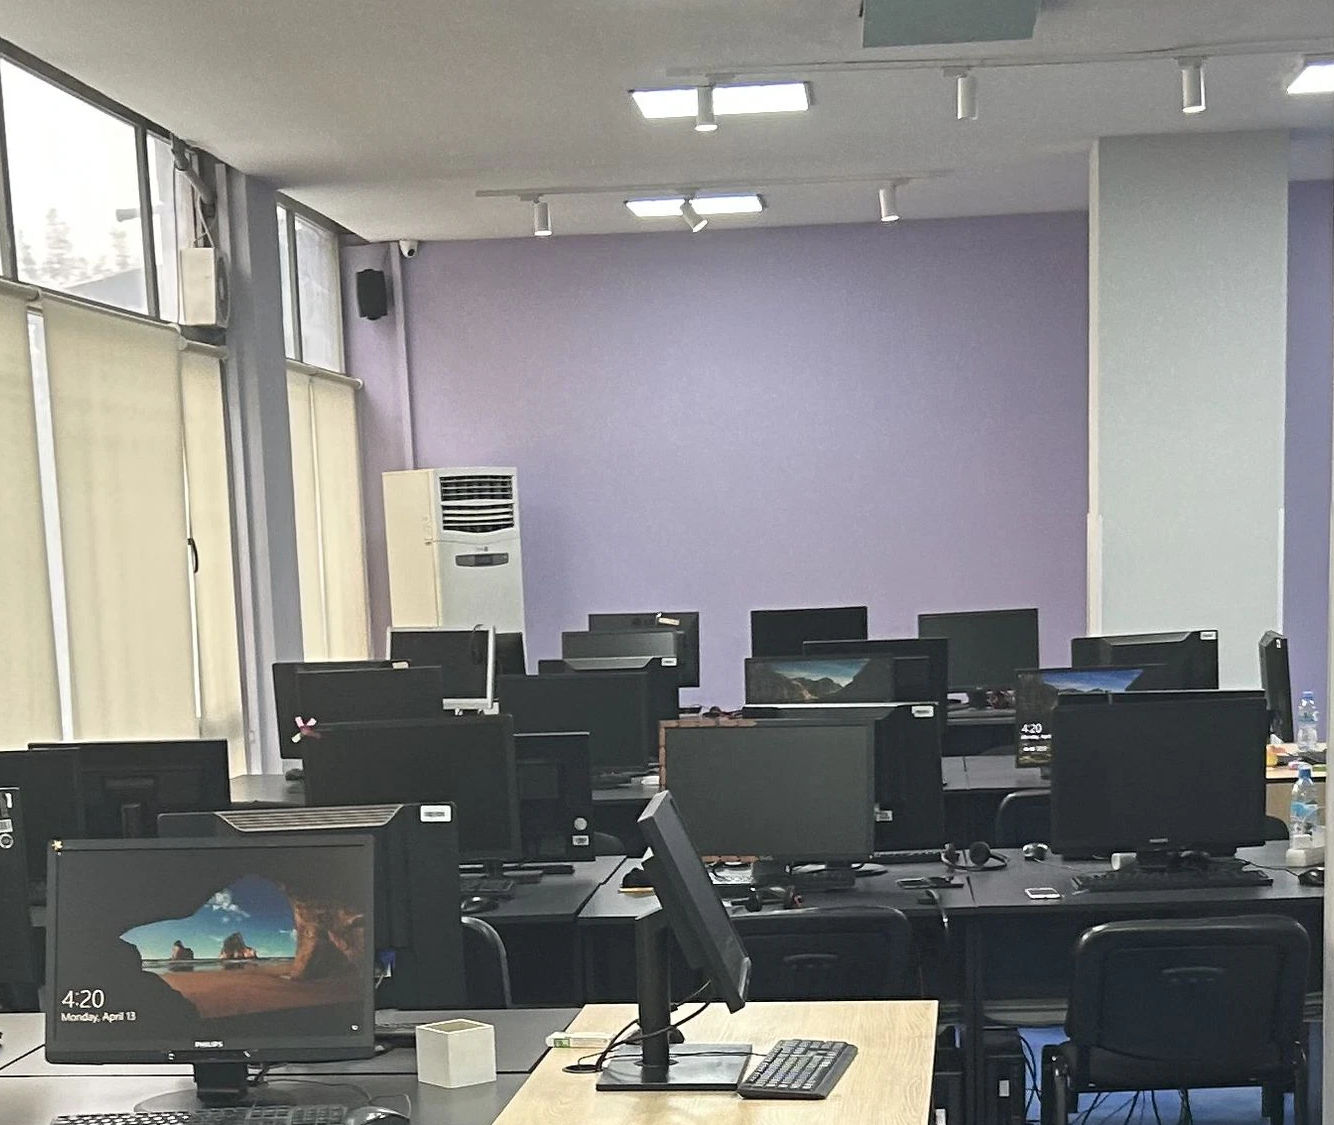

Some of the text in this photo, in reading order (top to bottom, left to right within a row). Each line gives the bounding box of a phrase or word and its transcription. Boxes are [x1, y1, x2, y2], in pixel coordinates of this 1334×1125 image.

[61, 989, 105, 1009] 4:20
[61, 1011, 137, 1024] Monday, April 13
